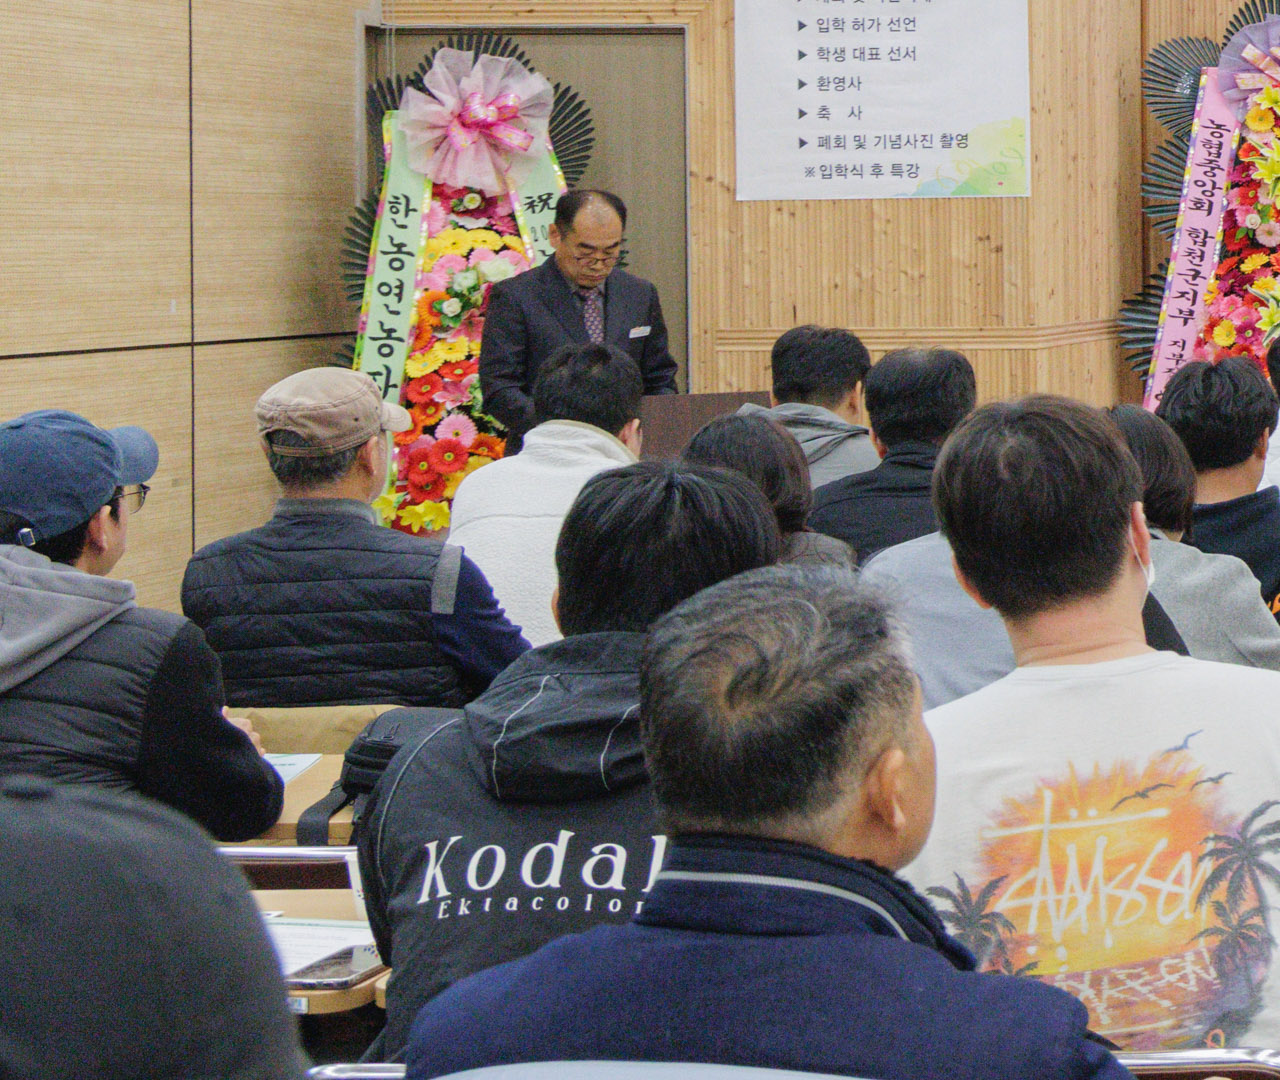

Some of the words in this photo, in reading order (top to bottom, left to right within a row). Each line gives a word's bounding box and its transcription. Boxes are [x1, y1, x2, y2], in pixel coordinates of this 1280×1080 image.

[816, 17, 846, 34] 입학
[851, 17, 881, 33] 허가
[887, 16, 916, 32] 선언
[816, 46, 846, 63] 학생
[852, 46, 881, 62] 대표
[887, 46, 916, 62] 선서
[816, 75, 862, 92] 환영사
[816, 105, 831, 121] 축
[847, 105, 863, 121] 사
[816, 134, 847, 150] 폐회
[853, 134, 867, 150] 및
[873, 134, 934, 150] 기념사진
[939, 132, 969, 149] 촬영
[869, 163, 885, 179] 후
[890, 163, 920, 179] 특강
[1188, 119, 1231, 217] 농협중앙회
[1168, 227, 1215, 327] 합천군지부
